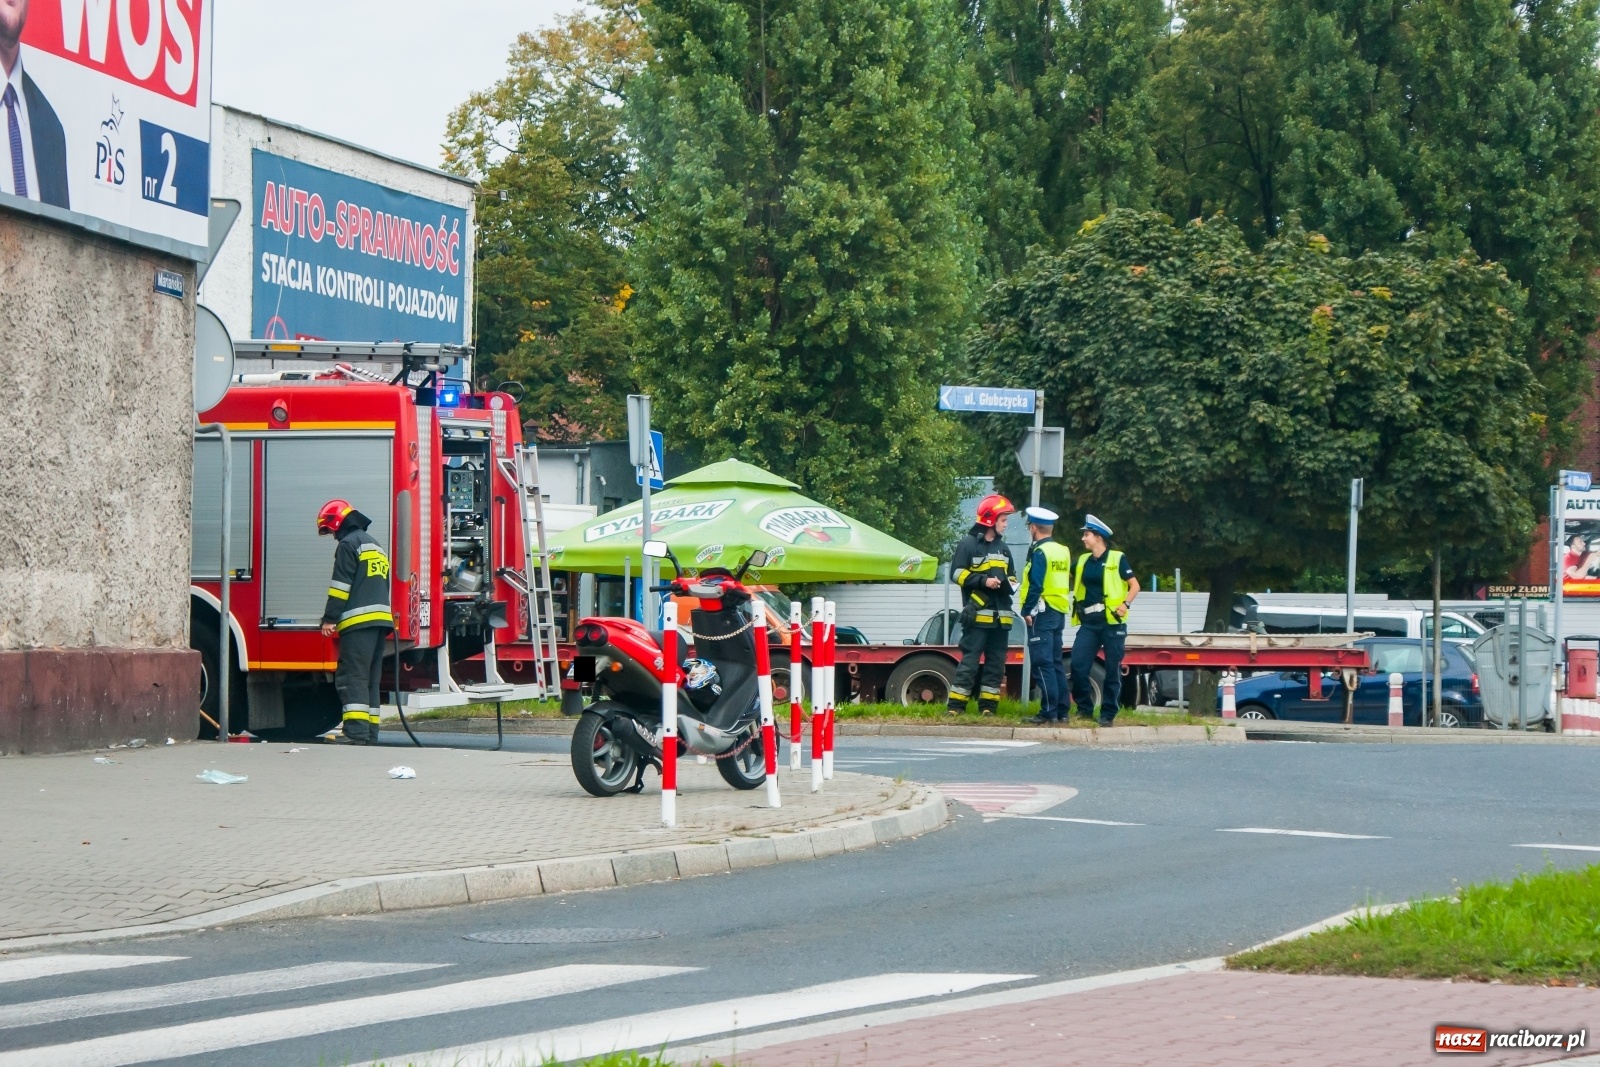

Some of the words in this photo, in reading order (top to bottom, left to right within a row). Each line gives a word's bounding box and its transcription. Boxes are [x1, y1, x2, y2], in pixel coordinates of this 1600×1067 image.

[144, 175, 158, 198] nr
[158, 131, 177, 205] 2
[261, 180, 460, 277] AUTO-SPRAWNOŚĆ
[261, 251, 313, 293] STACJA
[316, 264, 384, 309] KONTROLI
[388, 281, 458, 324] POJAZDÓW
[964, 392, 976, 406] ul.
[979, 392, 1028, 409] Głubczycka
[593, 502, 724, 536] TYMBARK
[765, 510, 841, 537] TYMBARK
[1489, 585, 1517, 593] SKUP
